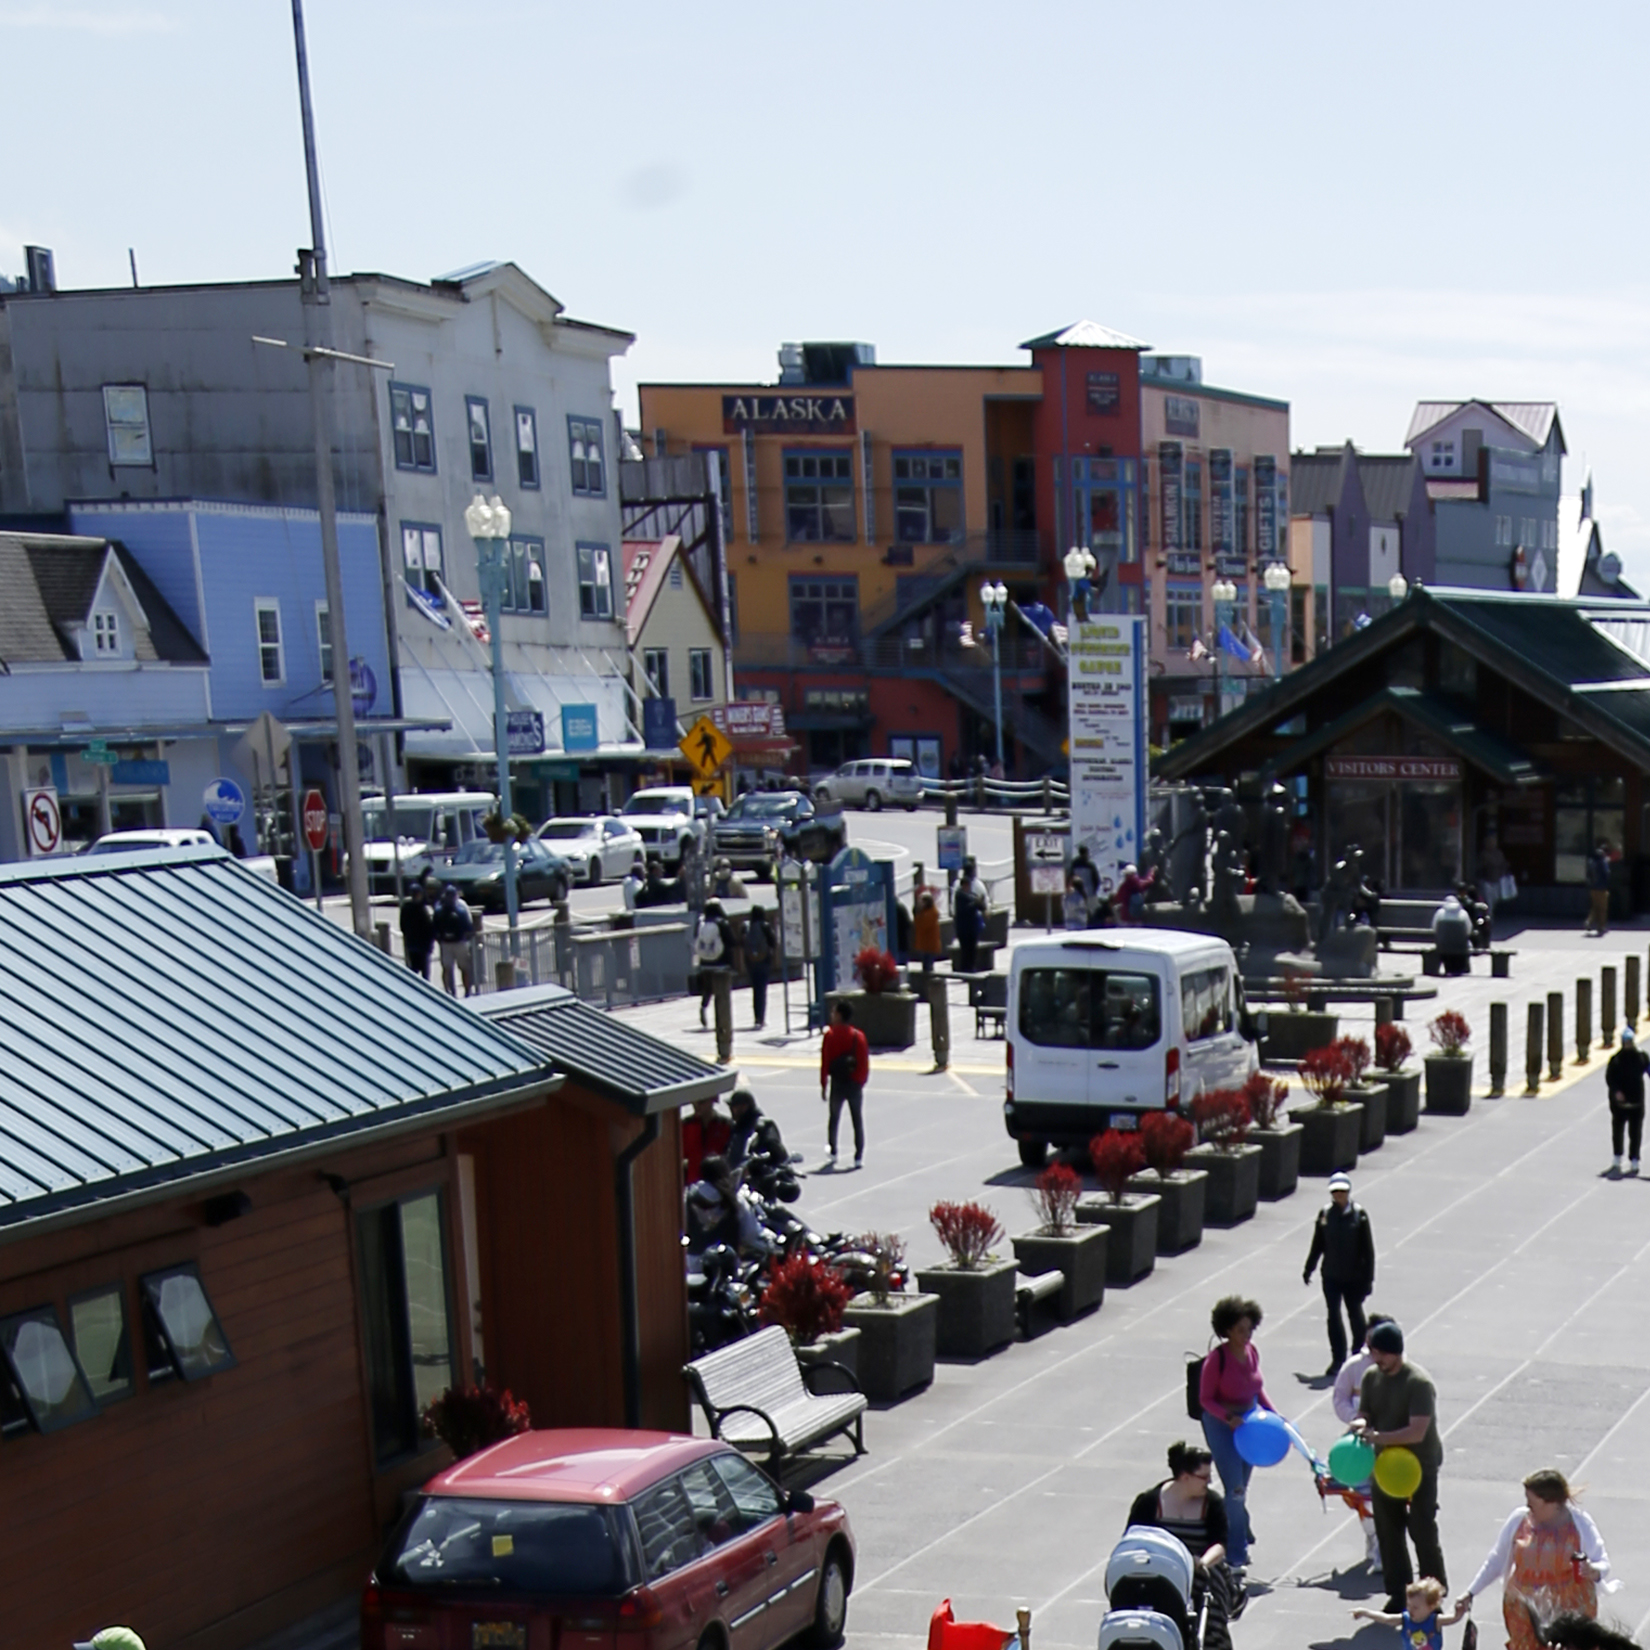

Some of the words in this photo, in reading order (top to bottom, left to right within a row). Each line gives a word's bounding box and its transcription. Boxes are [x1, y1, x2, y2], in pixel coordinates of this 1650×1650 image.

[731, 397, 847, 422] ALASKA
[1164, 483, 1179, 544] SALMON
[1258, 496, 1273, 550] GIFTS
[1327, 761, 1396, 776] VISITORS
[1400, 762, 1461, 776] CENTER
[305, 810, 327, 832] STOP
[1035, 837, 1059, 848] EXIT
